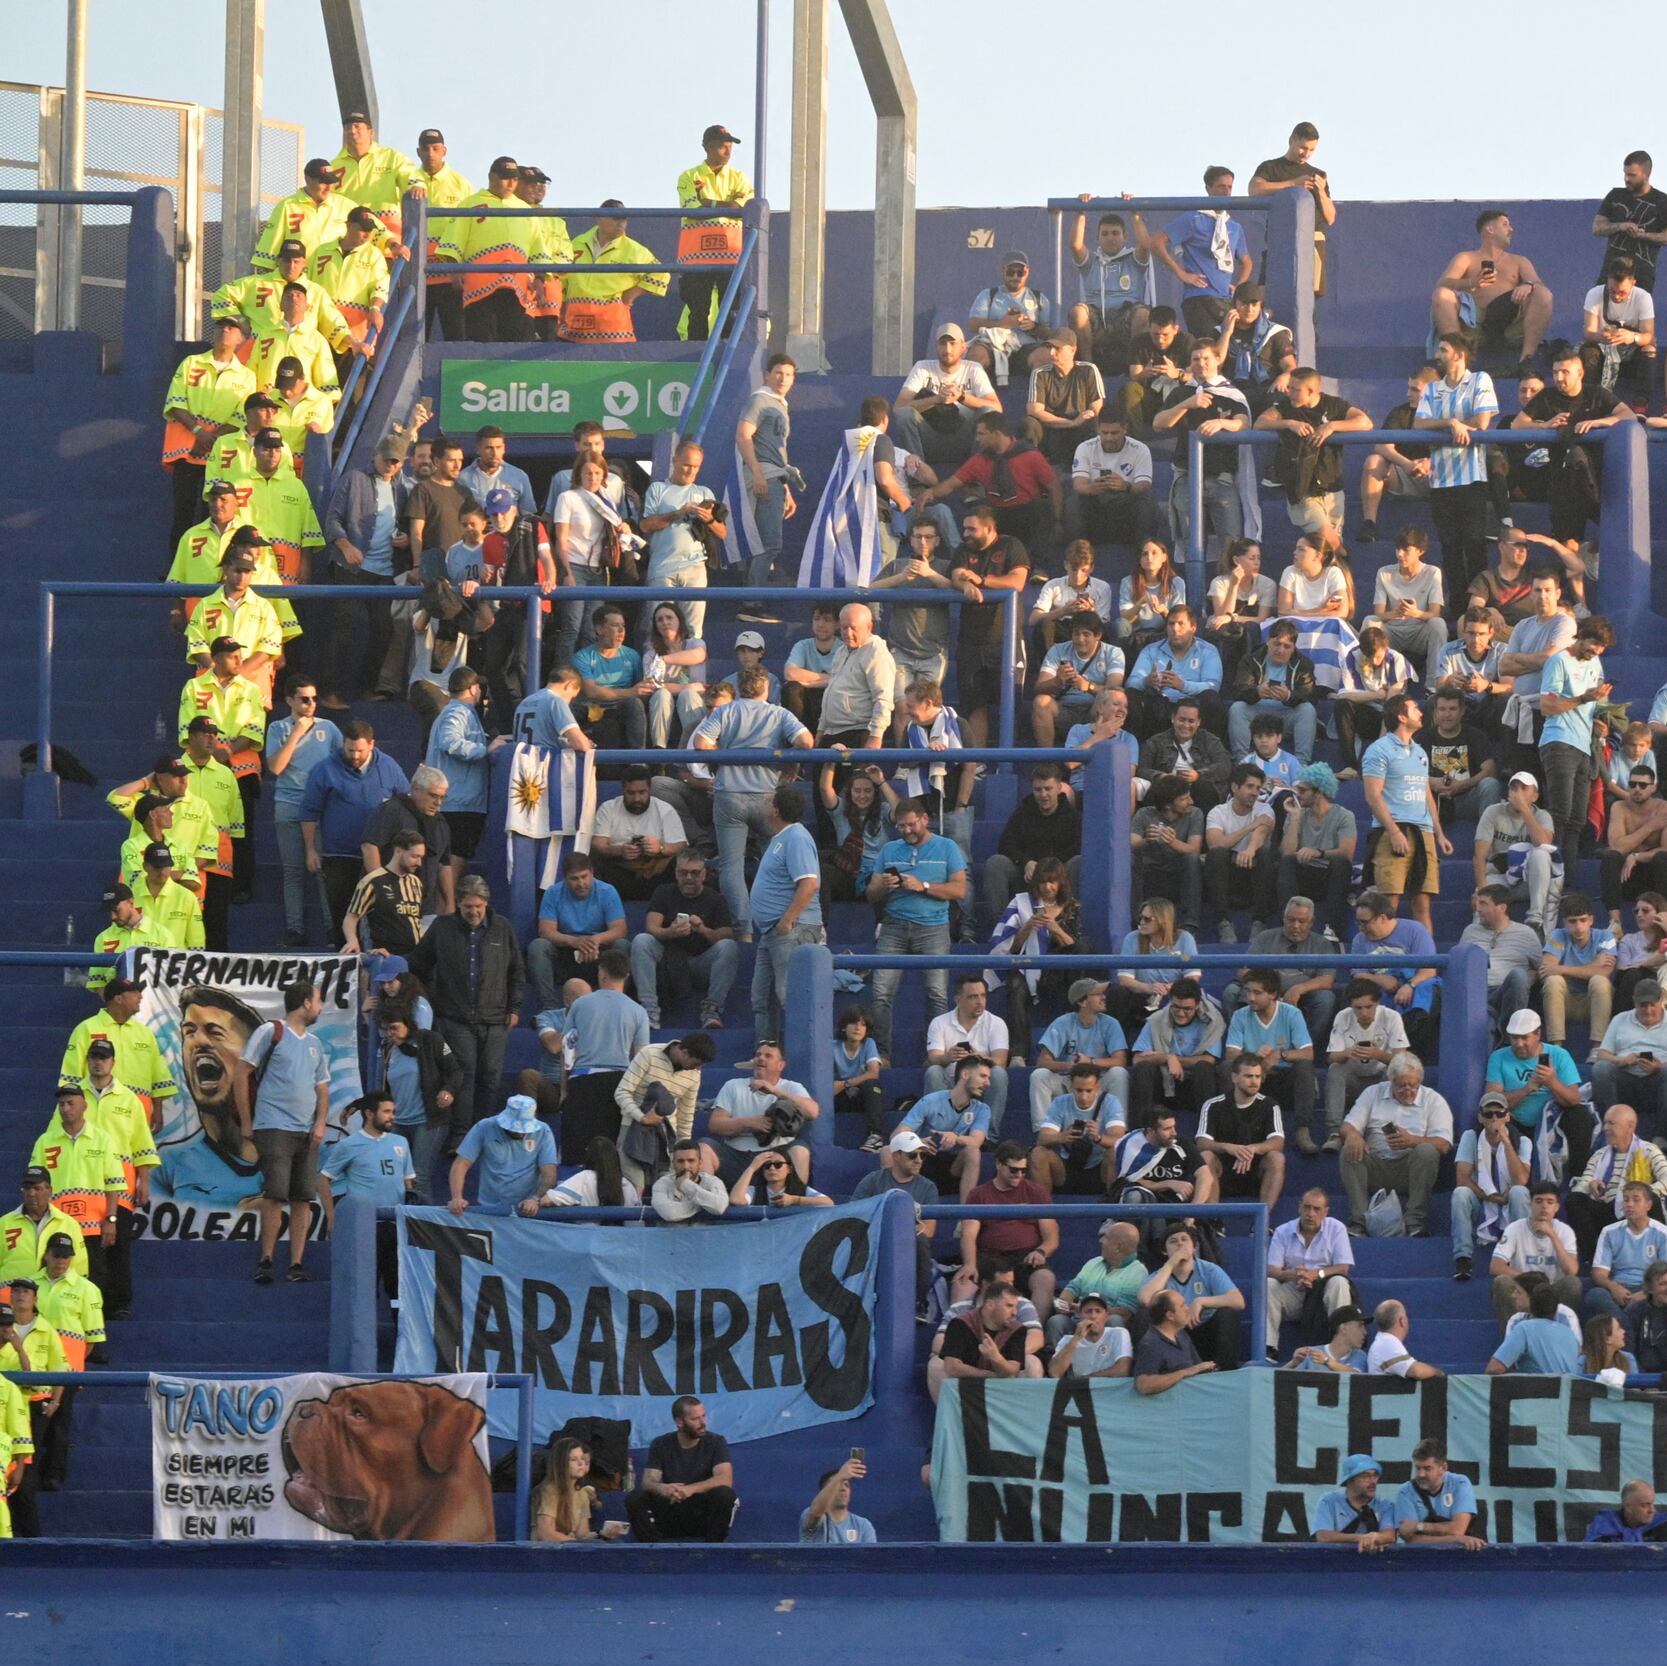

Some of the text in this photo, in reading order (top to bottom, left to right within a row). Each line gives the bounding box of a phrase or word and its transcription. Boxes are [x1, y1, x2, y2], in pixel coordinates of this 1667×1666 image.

[460, 381, 570, 415] Salida
[465, 562, 480, 581] 20
[513, 712, 537, 743] 15
[134, 947, 357, 1009] ETERNAMENTE
[380, 1159, 396, 1176] 15
[404, 1216, 870, 1412] TARARIRAS
[156, 1382, 284, 1436] TANO
[958, 1377, 1110, 1485] LA
[168, 1453, 270, 1475] SIEMPRE
[164, 1483, 274, 1505] ESTARAS
[185, 1515, 256, 1537] EN MI
